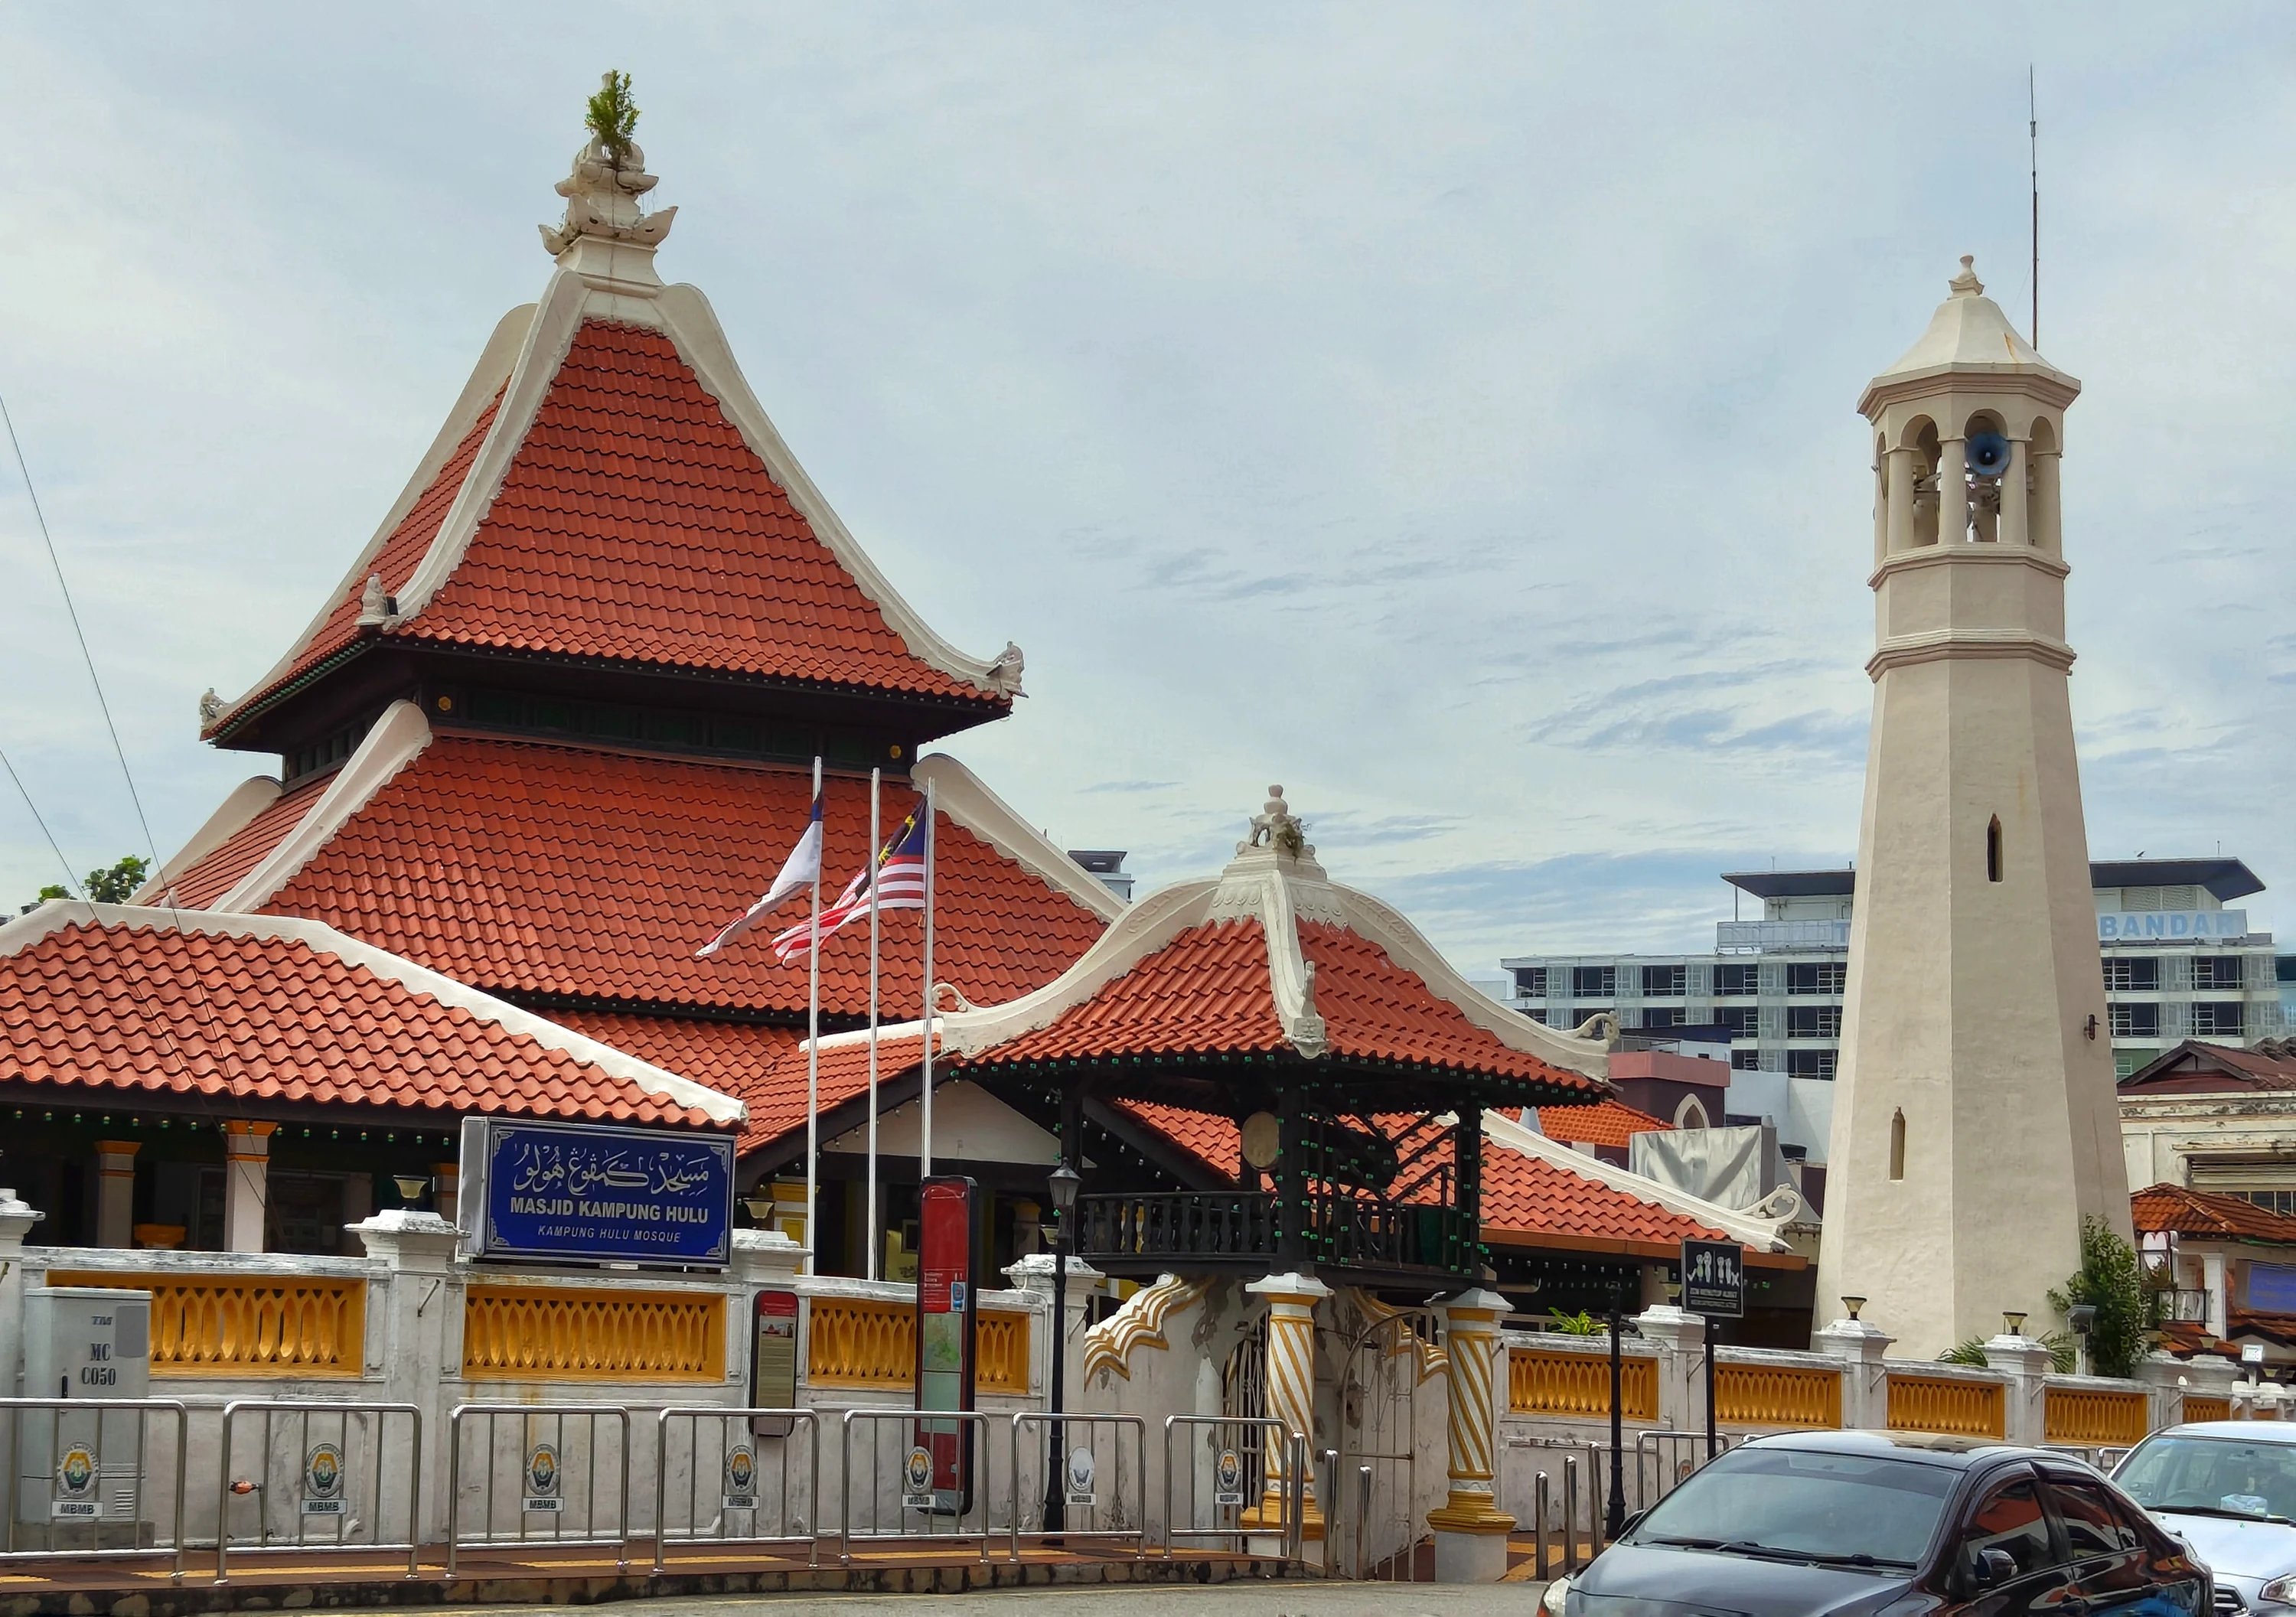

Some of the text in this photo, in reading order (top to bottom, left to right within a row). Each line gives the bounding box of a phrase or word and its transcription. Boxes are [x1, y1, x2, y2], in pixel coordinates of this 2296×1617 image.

[2100, 913, 2234, 937] BANDAR
[510, 1196, 709, 1224] MASJID KAMPUNG HULU
[537, 1224, 682, 1243] KAMPUNG HULU MOSQUE
[90, 1343, 111, 1361] MC
[81, 1367, 116, 1386] C050
[60, 1503, 95, 1514] MBMB
